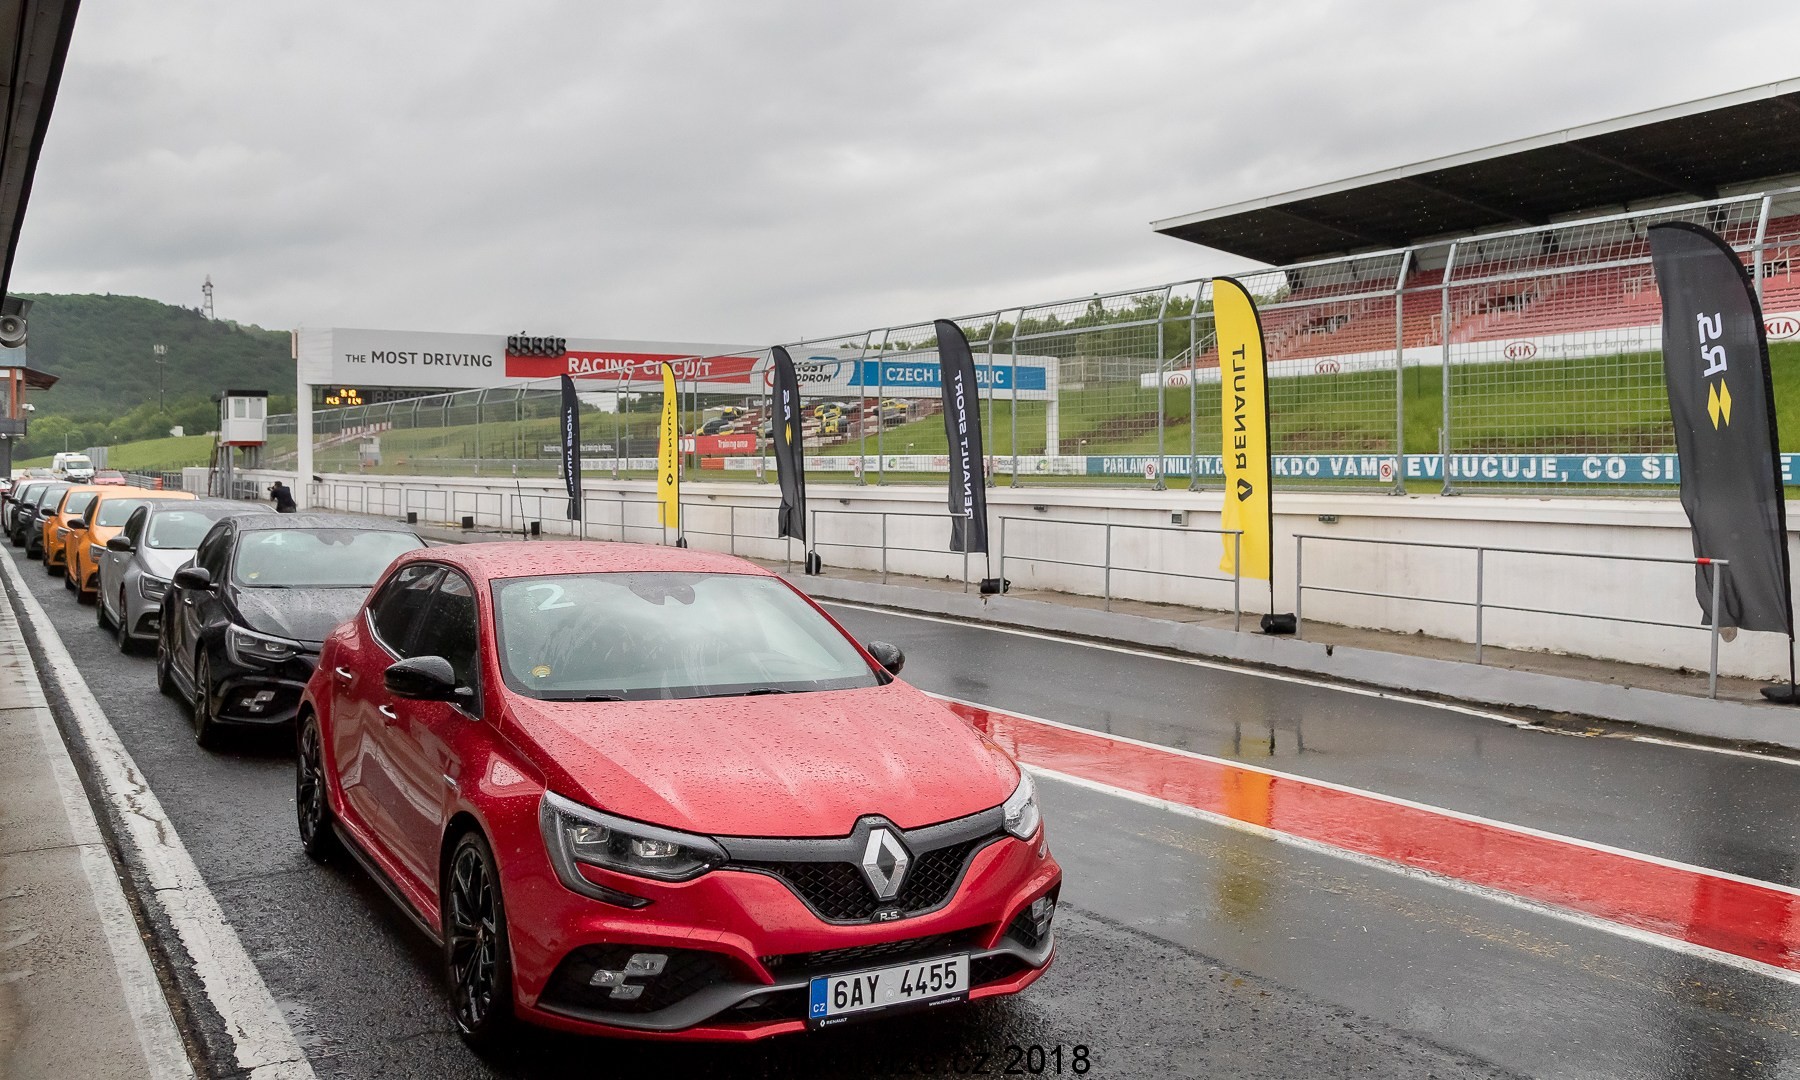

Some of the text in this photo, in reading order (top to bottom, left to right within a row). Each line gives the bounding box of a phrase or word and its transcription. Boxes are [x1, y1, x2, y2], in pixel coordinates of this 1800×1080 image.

[1764, 321, 1793, 335] KIA
[1509, 346, 1532, 357] KIA
[345, 351, 492, 367] THE MOST DRIVING
[568, 357, 635, 375] RACING
[886, 367, 934, 382] CZECH
[1319, 363, 1336, 373] KIA
[1171, 376, 1184, 386] KIA
[1275, 457, 1320, 476] KDO
[1582, 457, 1627, 480] CO
[1641, 456, 1674, 480] SI
[168, 511, 185, 522] 5
[261, 532, 286, 546] 4
[526, 583, 576, 611] 2
[833, 960, 958, 1009] 6AY 4455
[813, 1002, 826, 1013] CZ
[826, 1017, 848, 1025] RENAULT
